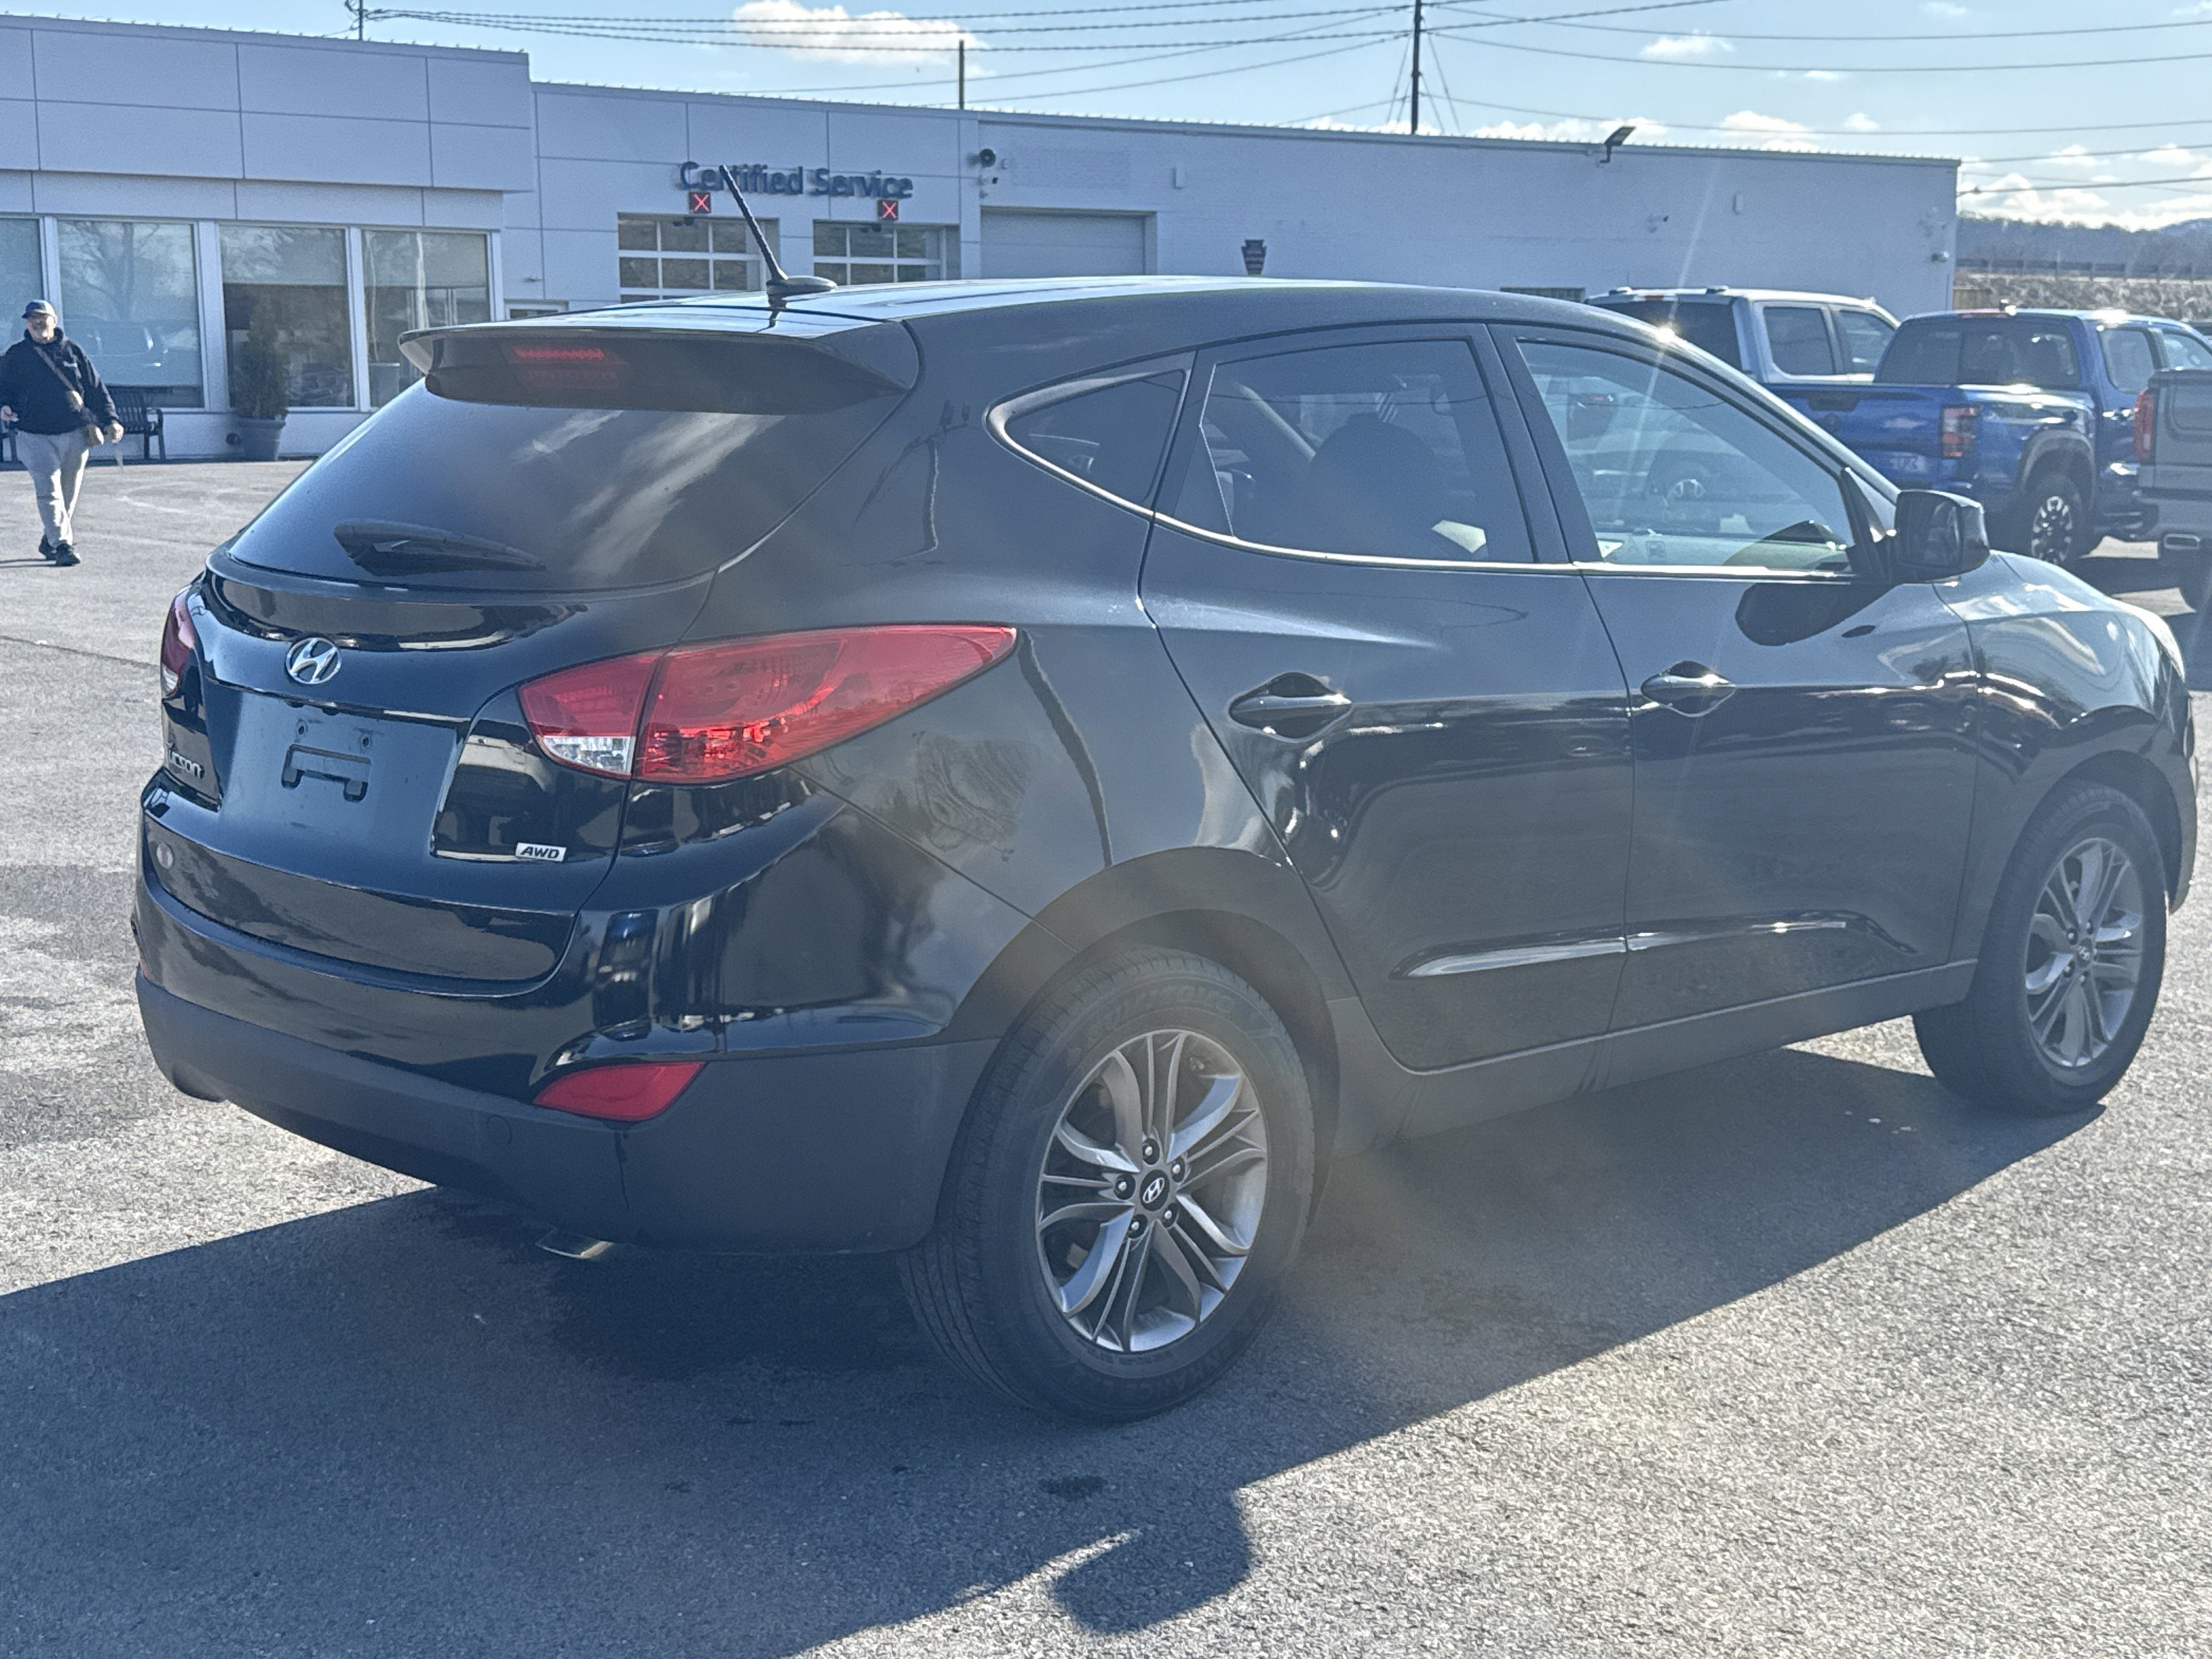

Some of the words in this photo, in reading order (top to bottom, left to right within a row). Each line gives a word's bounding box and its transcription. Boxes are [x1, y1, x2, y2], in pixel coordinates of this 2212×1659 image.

[680, 161, 804, 195] Certified
[814, 167, 913, 199] Service
[521, 846, 560, 859] AWD
